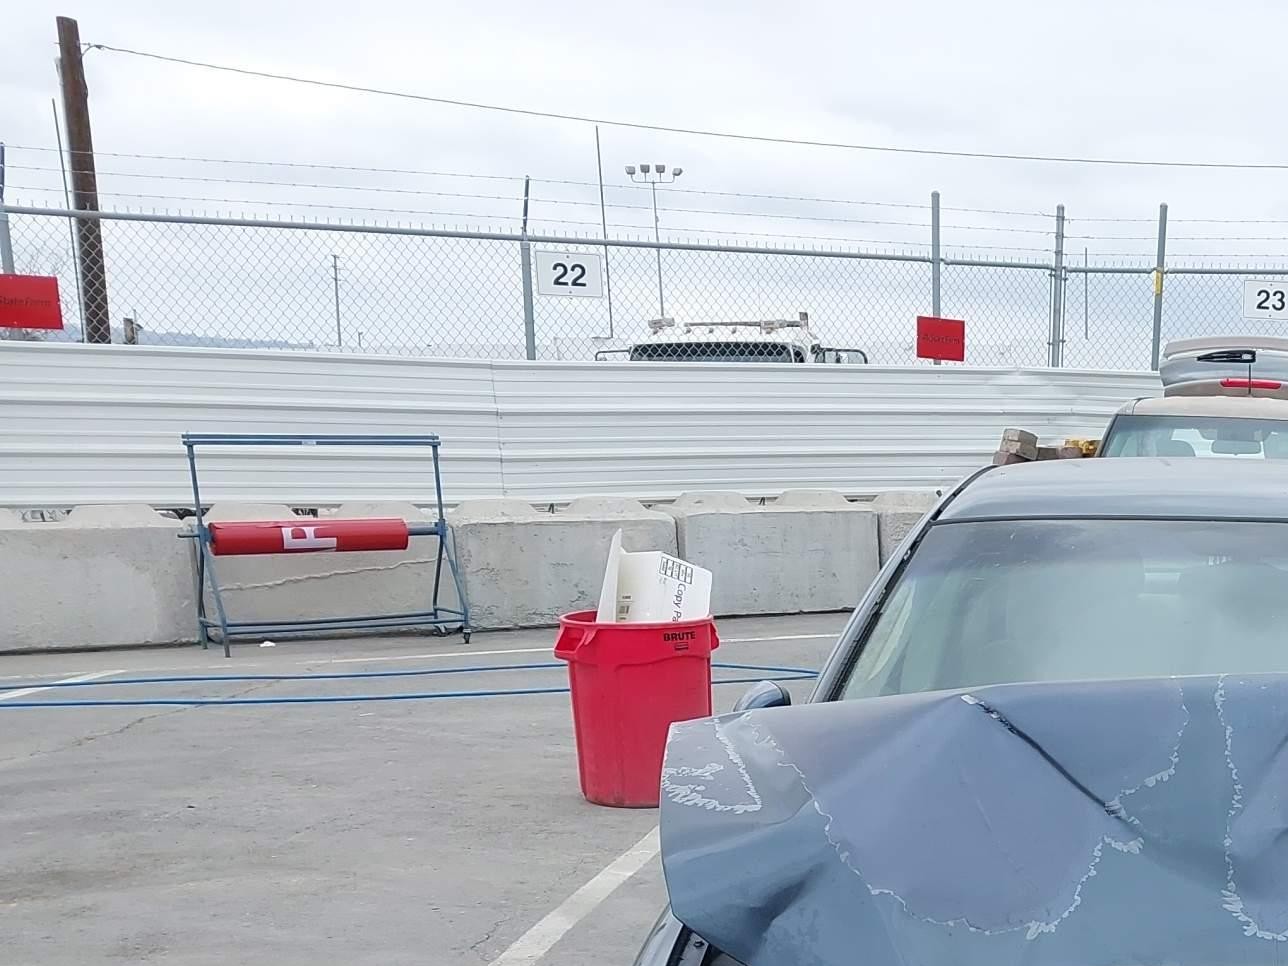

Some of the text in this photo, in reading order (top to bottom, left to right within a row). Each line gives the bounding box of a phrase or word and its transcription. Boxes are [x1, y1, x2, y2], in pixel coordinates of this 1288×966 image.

[552, 262, 587, 287] 22
[1256, 289, 1286, 311] 23
[672, 583, 687, 609] Copy
[663, 630, 696, 641] BRUTE
